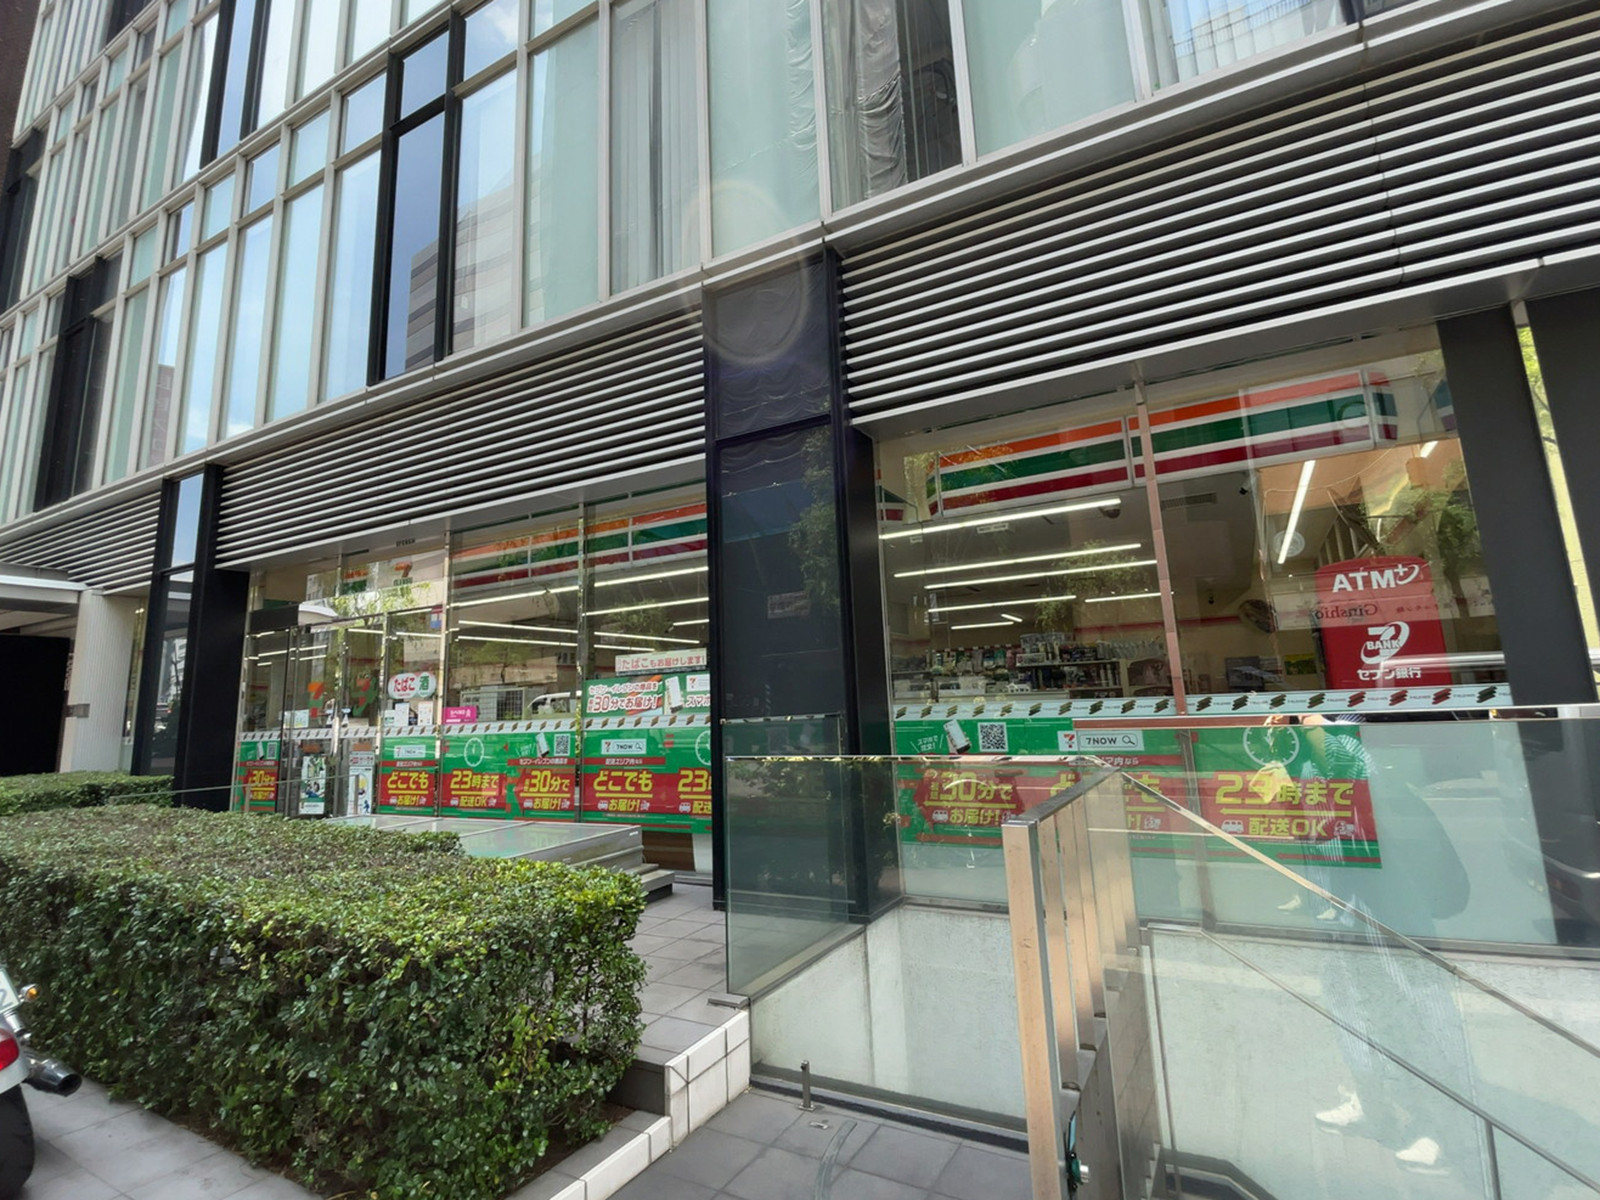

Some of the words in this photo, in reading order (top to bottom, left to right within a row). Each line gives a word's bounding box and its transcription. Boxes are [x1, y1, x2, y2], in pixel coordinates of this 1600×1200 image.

[1366, 637, 1401, 650] BANK
[1357, 667, 1422, 681] セブン銀行
[393, 677, 415, 692] たばこ
[419, 675, 430, 691] 酒
[1086, 737, 1117, 745] 7NOW
[387, 772, 429, 789] どこでも
[450, 770, 499, 789] 23時まで
[593, 771, 653, 792] どこでも
[1216, 773, 1354, 806] 23時まで
[534, 799, 561, 810] お届け!
[609, 799, 641, 812] お届け!
[950, 808, 1000, 825] お届け!
[1249, 818, 1328, 837] 配送OK
